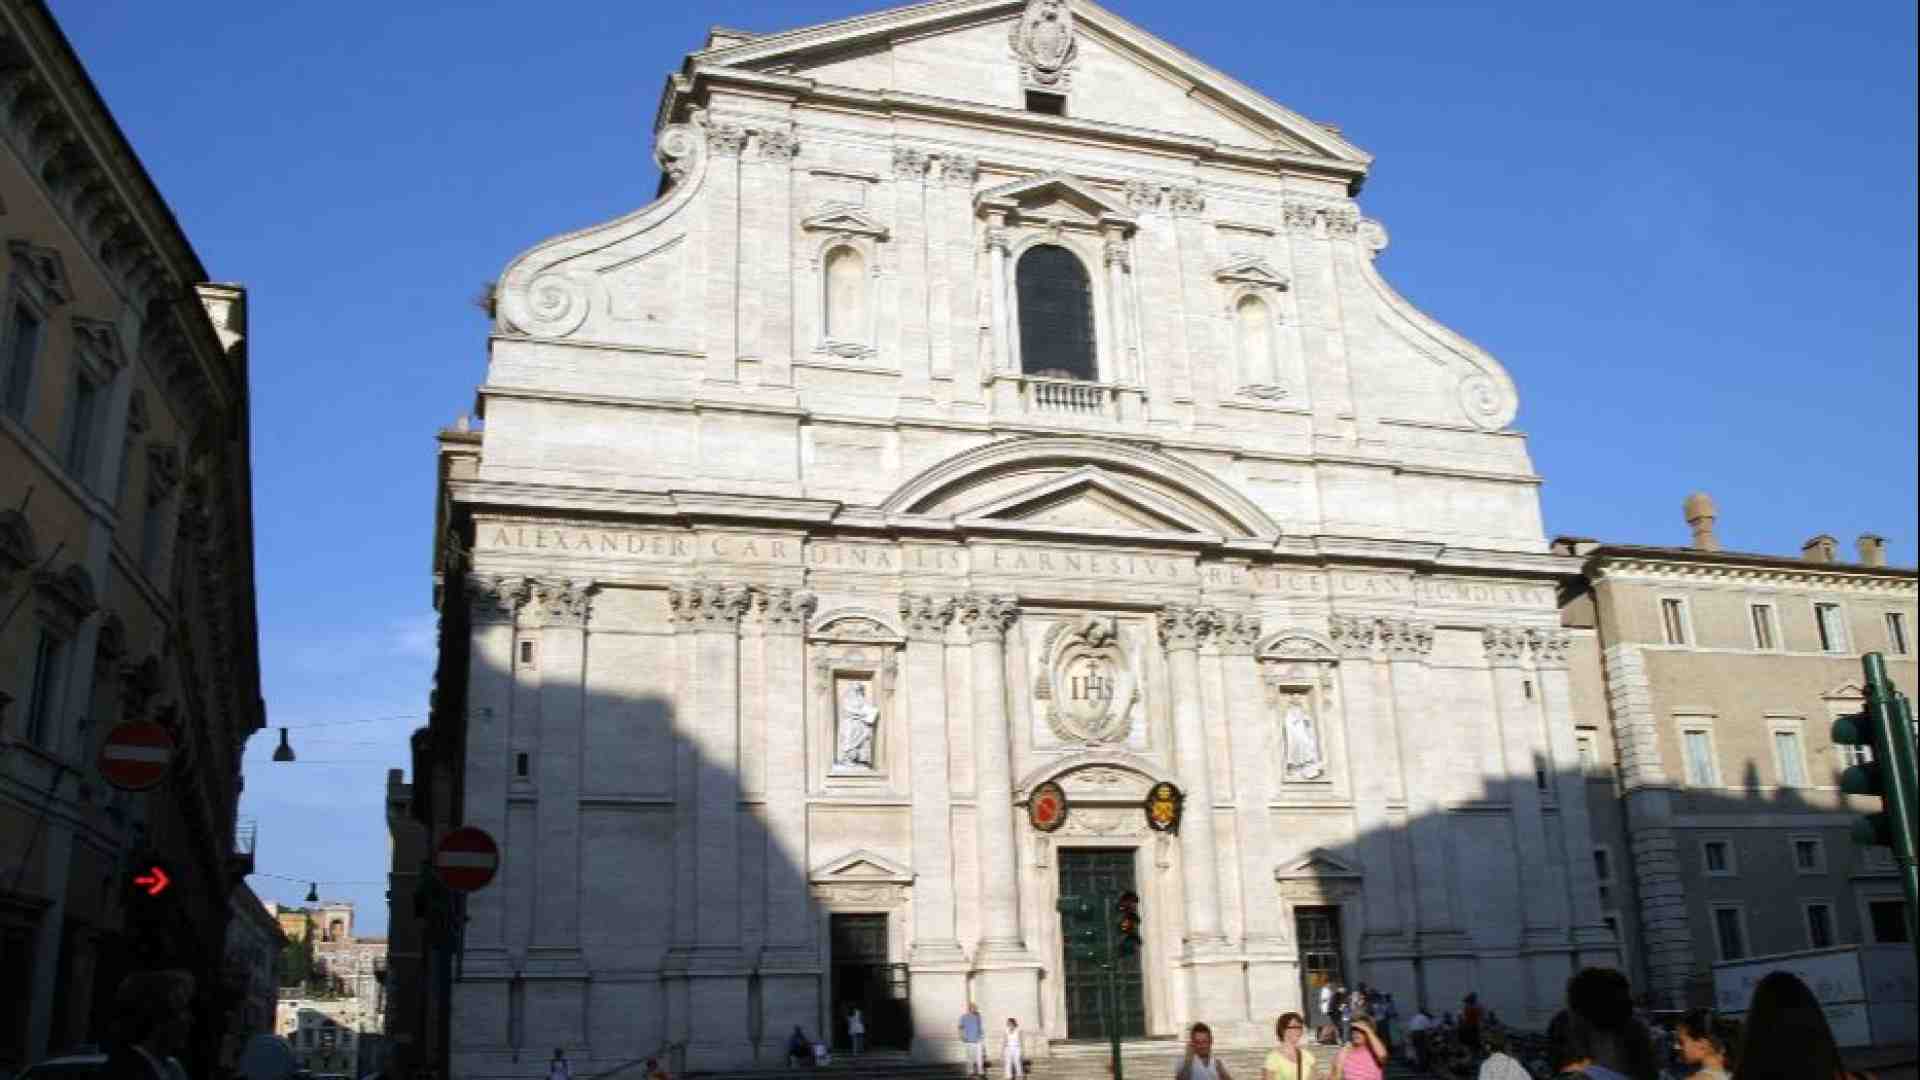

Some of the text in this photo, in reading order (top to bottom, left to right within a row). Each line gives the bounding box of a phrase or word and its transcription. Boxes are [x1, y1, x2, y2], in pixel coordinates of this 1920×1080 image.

[492, 527, 689, 557] ALEXANDER
[993, 554, 1178, 577] FARNESIVS
[1072, 673, 1113, 701] IHS
